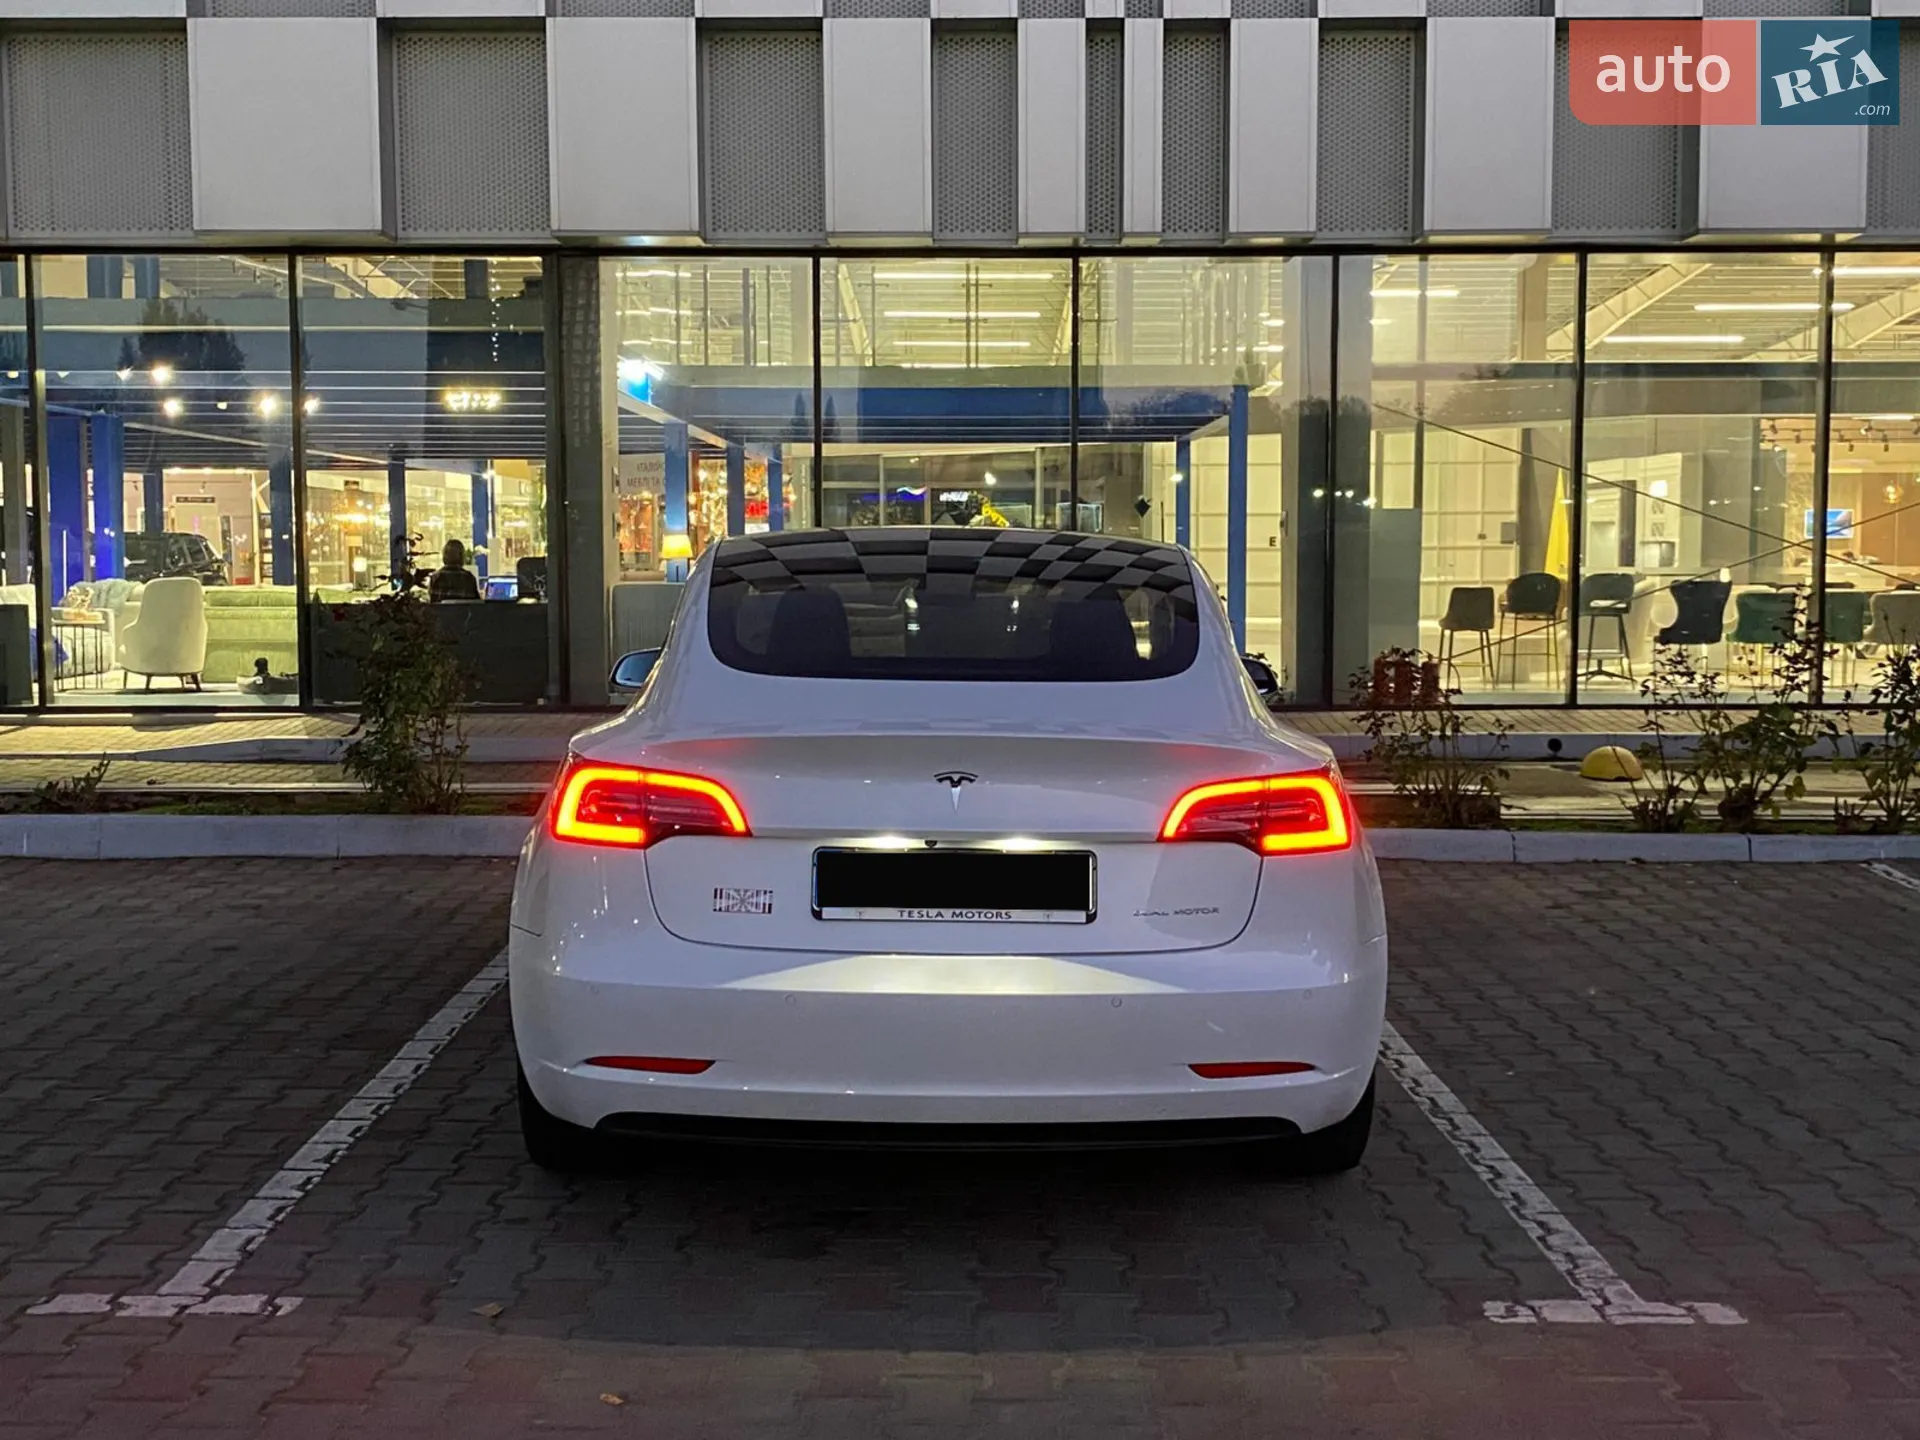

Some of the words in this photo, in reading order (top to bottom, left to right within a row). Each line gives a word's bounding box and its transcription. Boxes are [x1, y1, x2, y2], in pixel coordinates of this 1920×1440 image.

[898, 909, 944, 919] TESLA
[951, 910, 1012, 920] MOTORS
[1173, 907, 1220, 916] MOTOR
